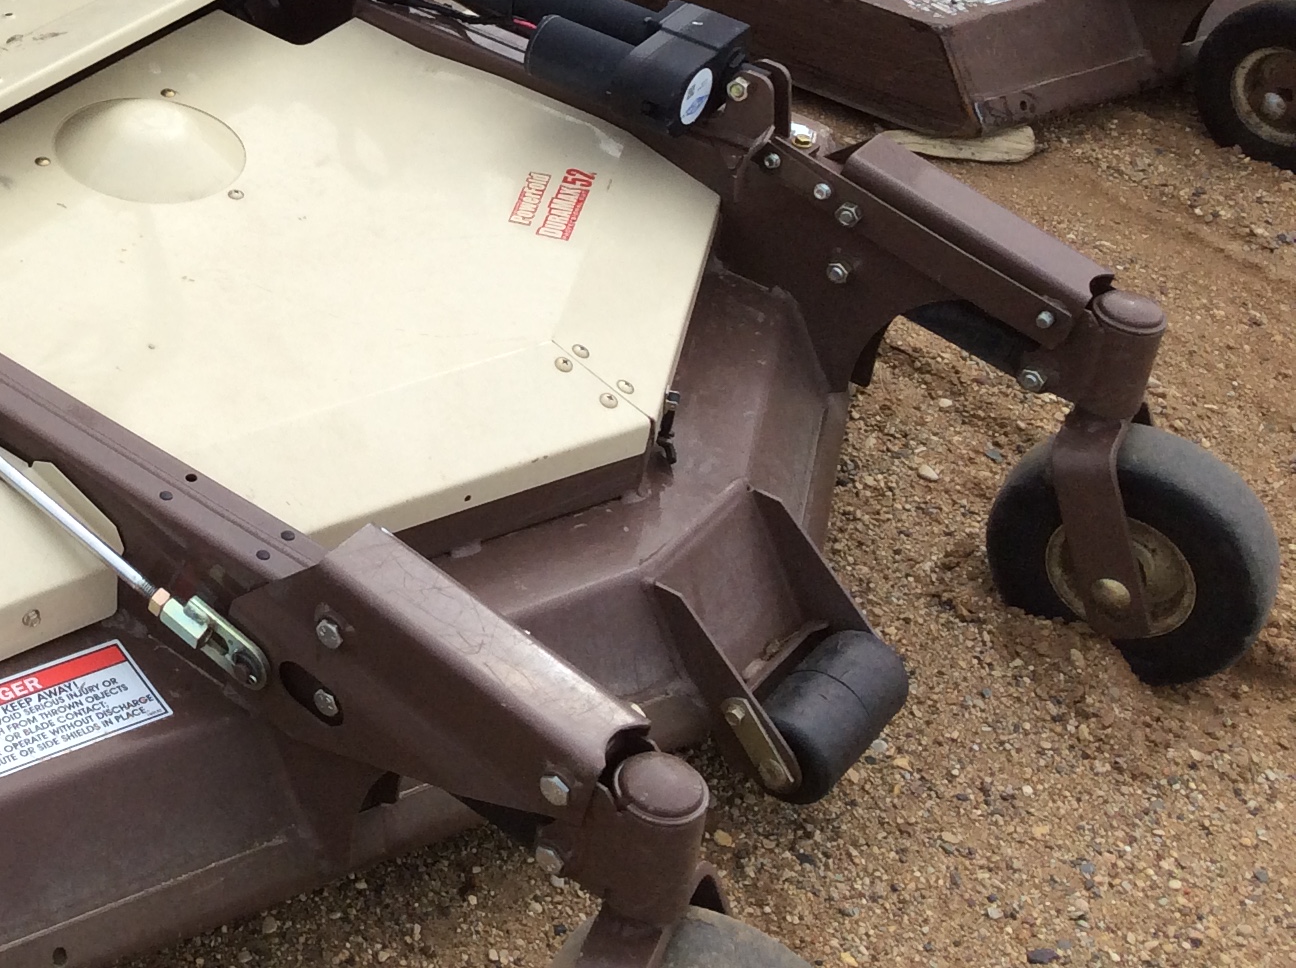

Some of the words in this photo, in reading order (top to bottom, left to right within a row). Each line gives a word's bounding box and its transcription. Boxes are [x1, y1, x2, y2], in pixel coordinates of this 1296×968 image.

[0, 696, 35, 714] KEEP
[33, 680, 79, 702] AWAY!
[6, 715, 39, 732] FROM
[38, 698, 84, 720] THROWN
[83, 683, 129, 704] OBJECTS
[22, 695, 66, 715] SERIOUS
[65, 682, 101, 700] INJURY
[100, 676, 118, 687] OR
[2, 732, 48, 753] OPERATE
[49, 715, 95, 736] WITHOUT
[94, 693, 154, 720] DISCHARGE
[3, 731, 23, 743] OR
[22, 719, 56, 736] BLADE
[18, 746, 37, 758] OR
[35, 737, 61, 751] SIDE
[60, 722, 102, 742] SHIELDS
[100, 718, 114, 727] IN
